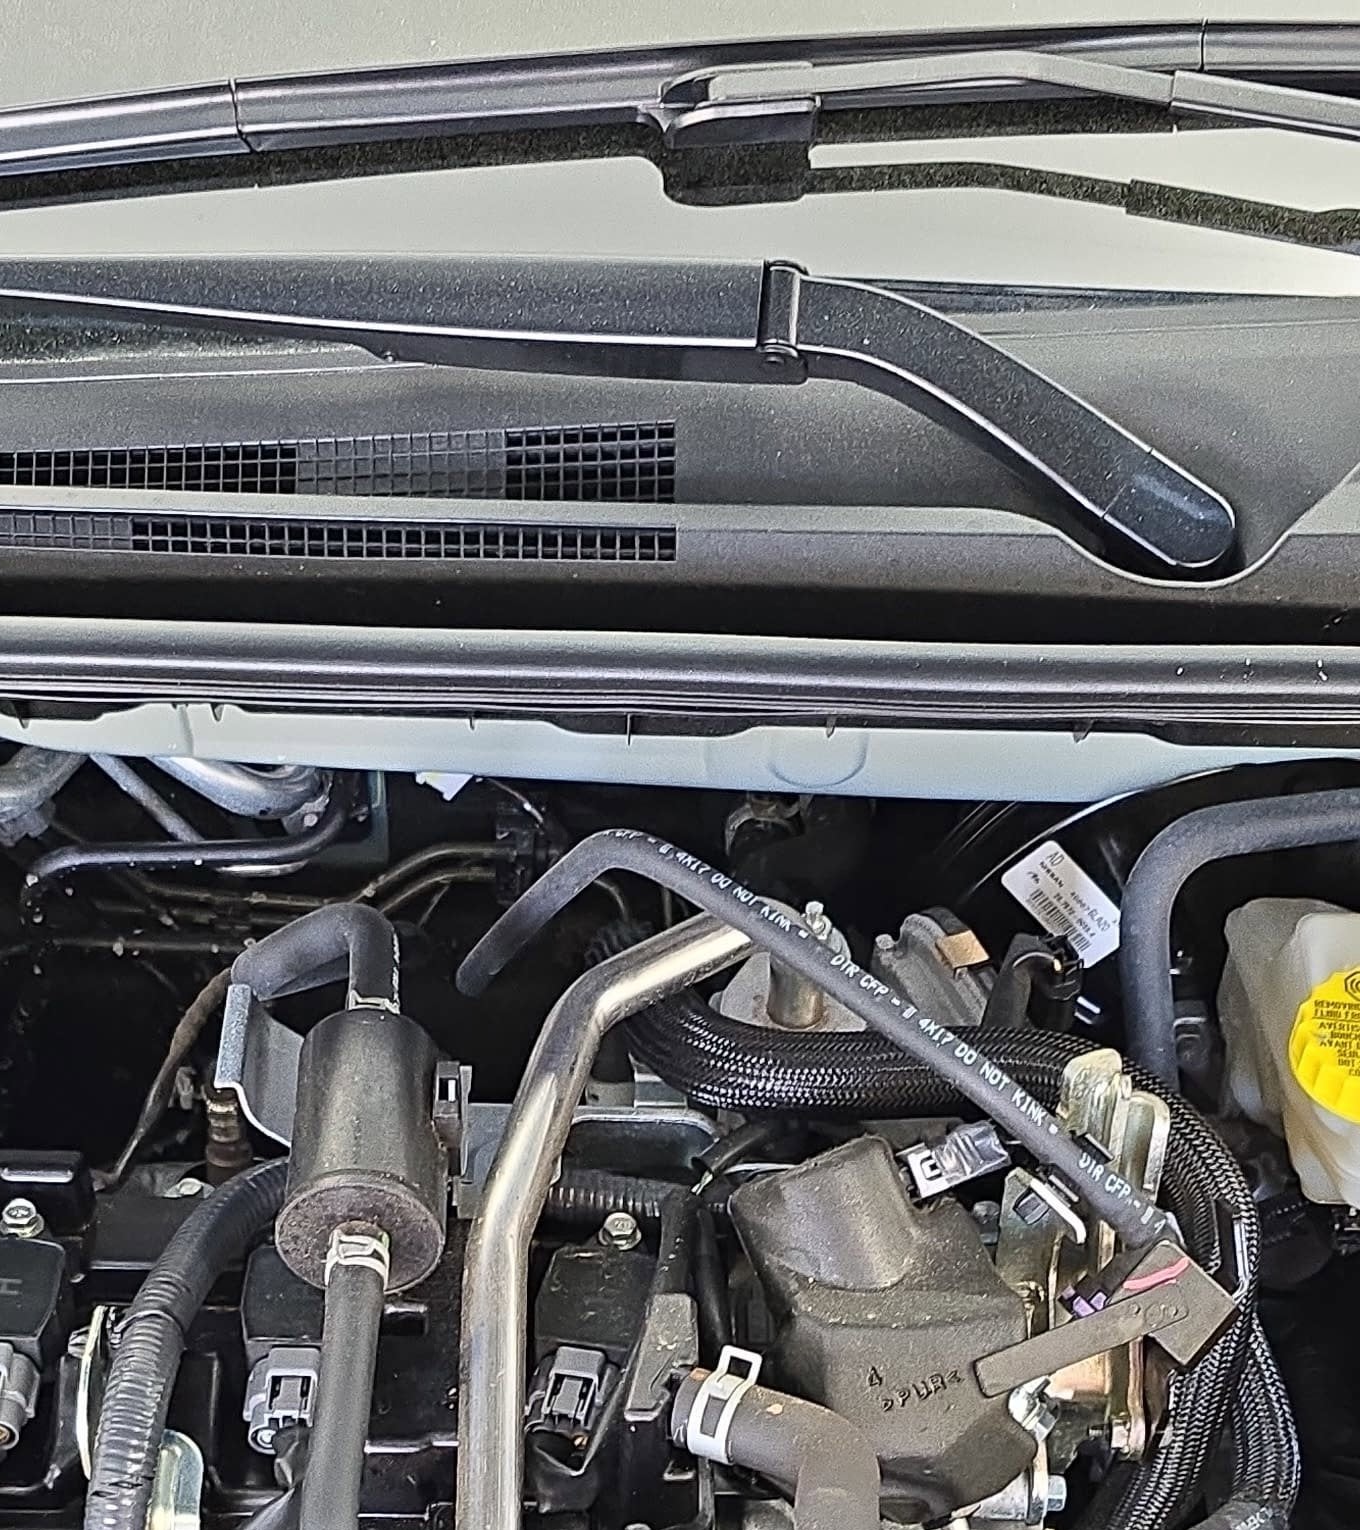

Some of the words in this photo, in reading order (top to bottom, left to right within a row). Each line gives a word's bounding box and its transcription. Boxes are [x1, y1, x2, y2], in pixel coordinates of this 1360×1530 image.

[733, 887, 760, 906] NOT
[830, 953, 859, 980] DTR
[860, 973, 890, 1001] CFP
[954, 1039, 978, 1065] DO
[979, 1061, 1010, 1092] NOT
[1011, 1089, 1048, 1127] KINK
